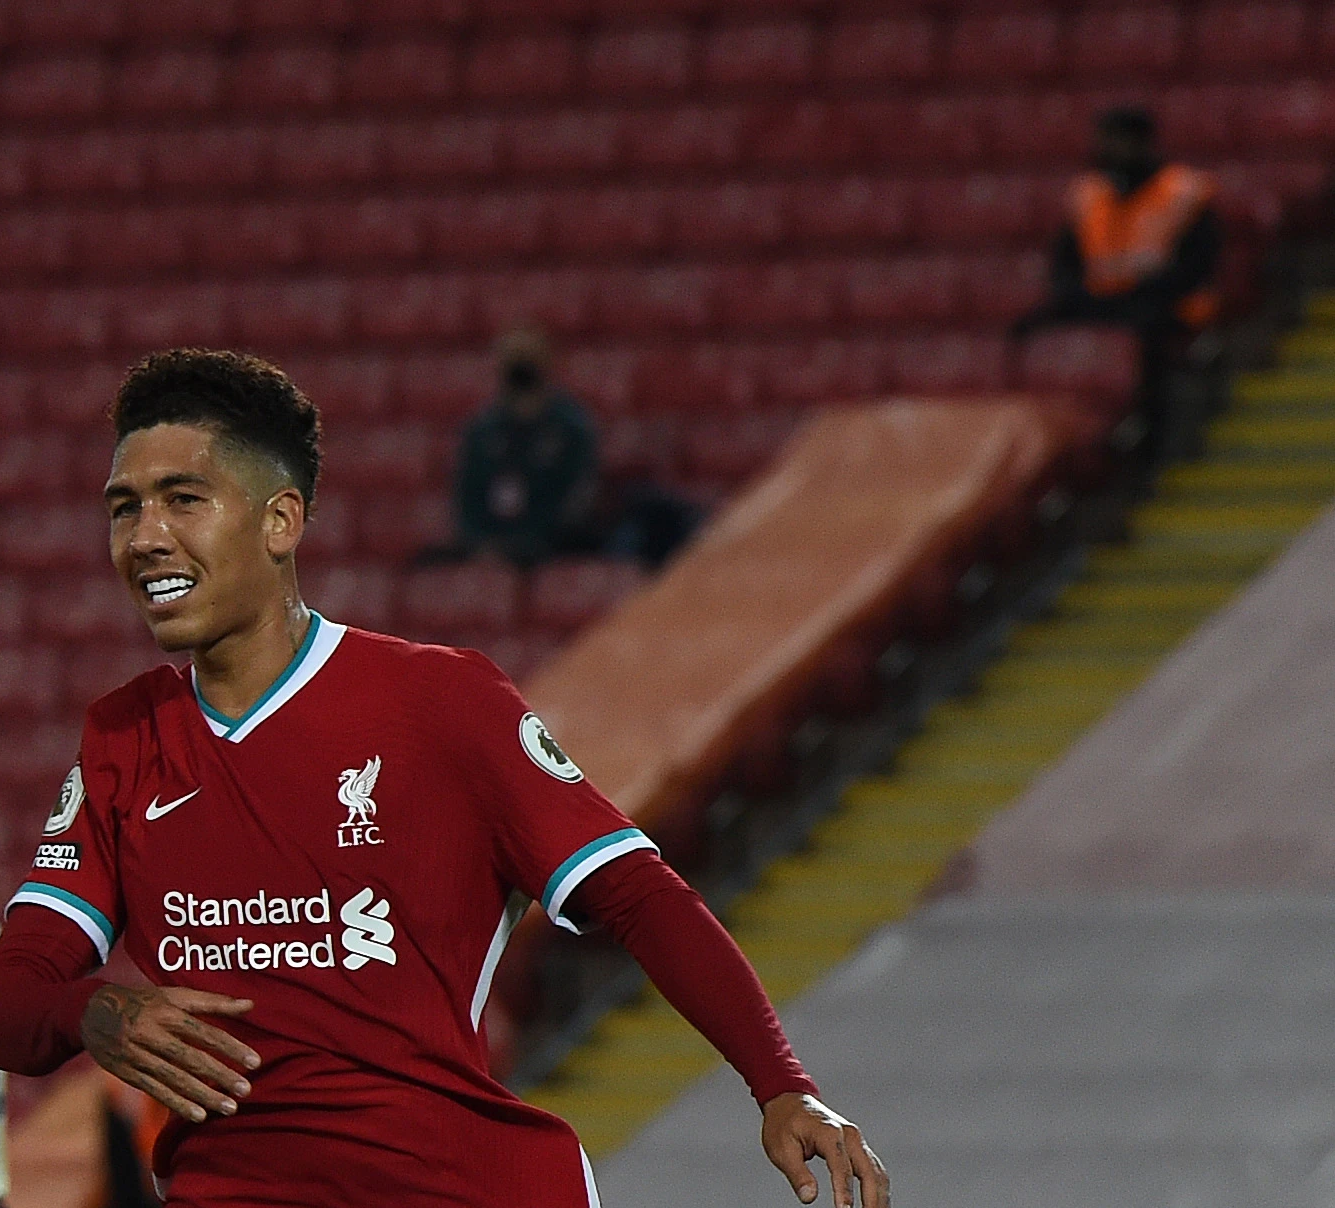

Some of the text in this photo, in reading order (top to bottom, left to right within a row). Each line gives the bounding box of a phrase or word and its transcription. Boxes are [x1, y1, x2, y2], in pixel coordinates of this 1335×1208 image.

[36, 844, 76, 858] room
[336, 826, 386, 848] L.F.C.
[163, 887, 331, 927] Standard
[157, 933, 336, 972] Chartered
